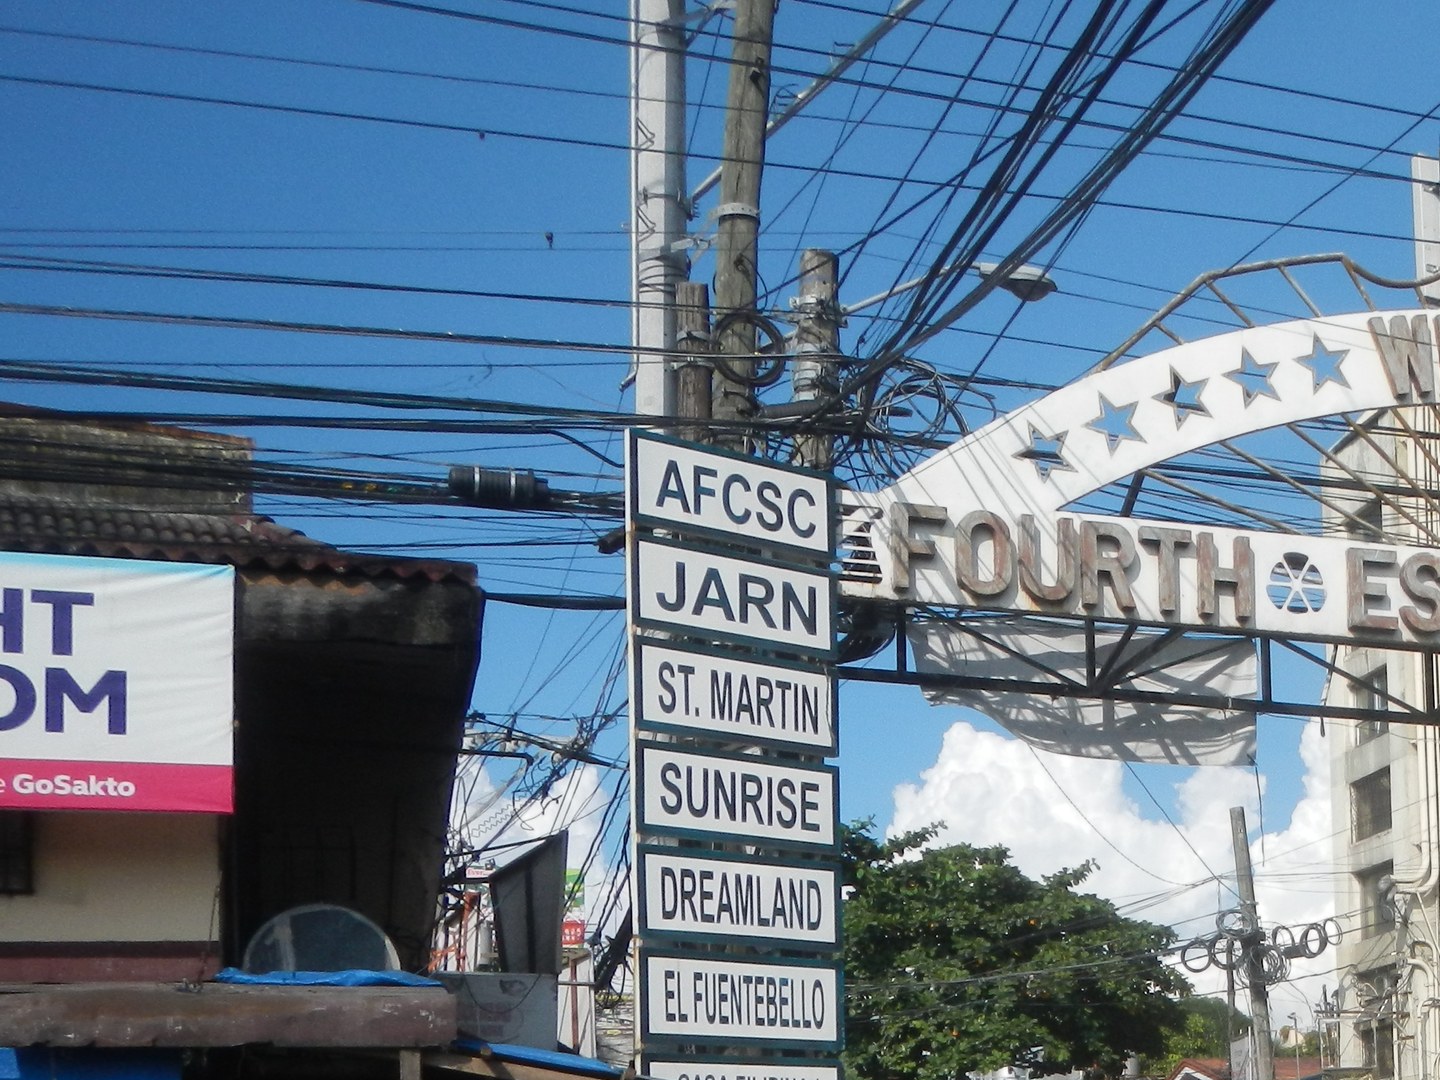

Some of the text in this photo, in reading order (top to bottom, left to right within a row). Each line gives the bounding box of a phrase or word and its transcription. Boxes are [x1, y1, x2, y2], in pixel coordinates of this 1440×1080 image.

[656, 459, 817, 539] AFCSC
[655, 561, 818, 637] JARN
[890, 501, 1257, 625] FOURTH
[658, 660, 819, 736] ST. MARTIN
[12, 773, 136, 798] GoSakto
[660, 762, 821, 833] SUNRISE
[660, 866, 823, 932] DREAMLAND
[664, 970, 825, 1030] EL FUENTEBELLO
